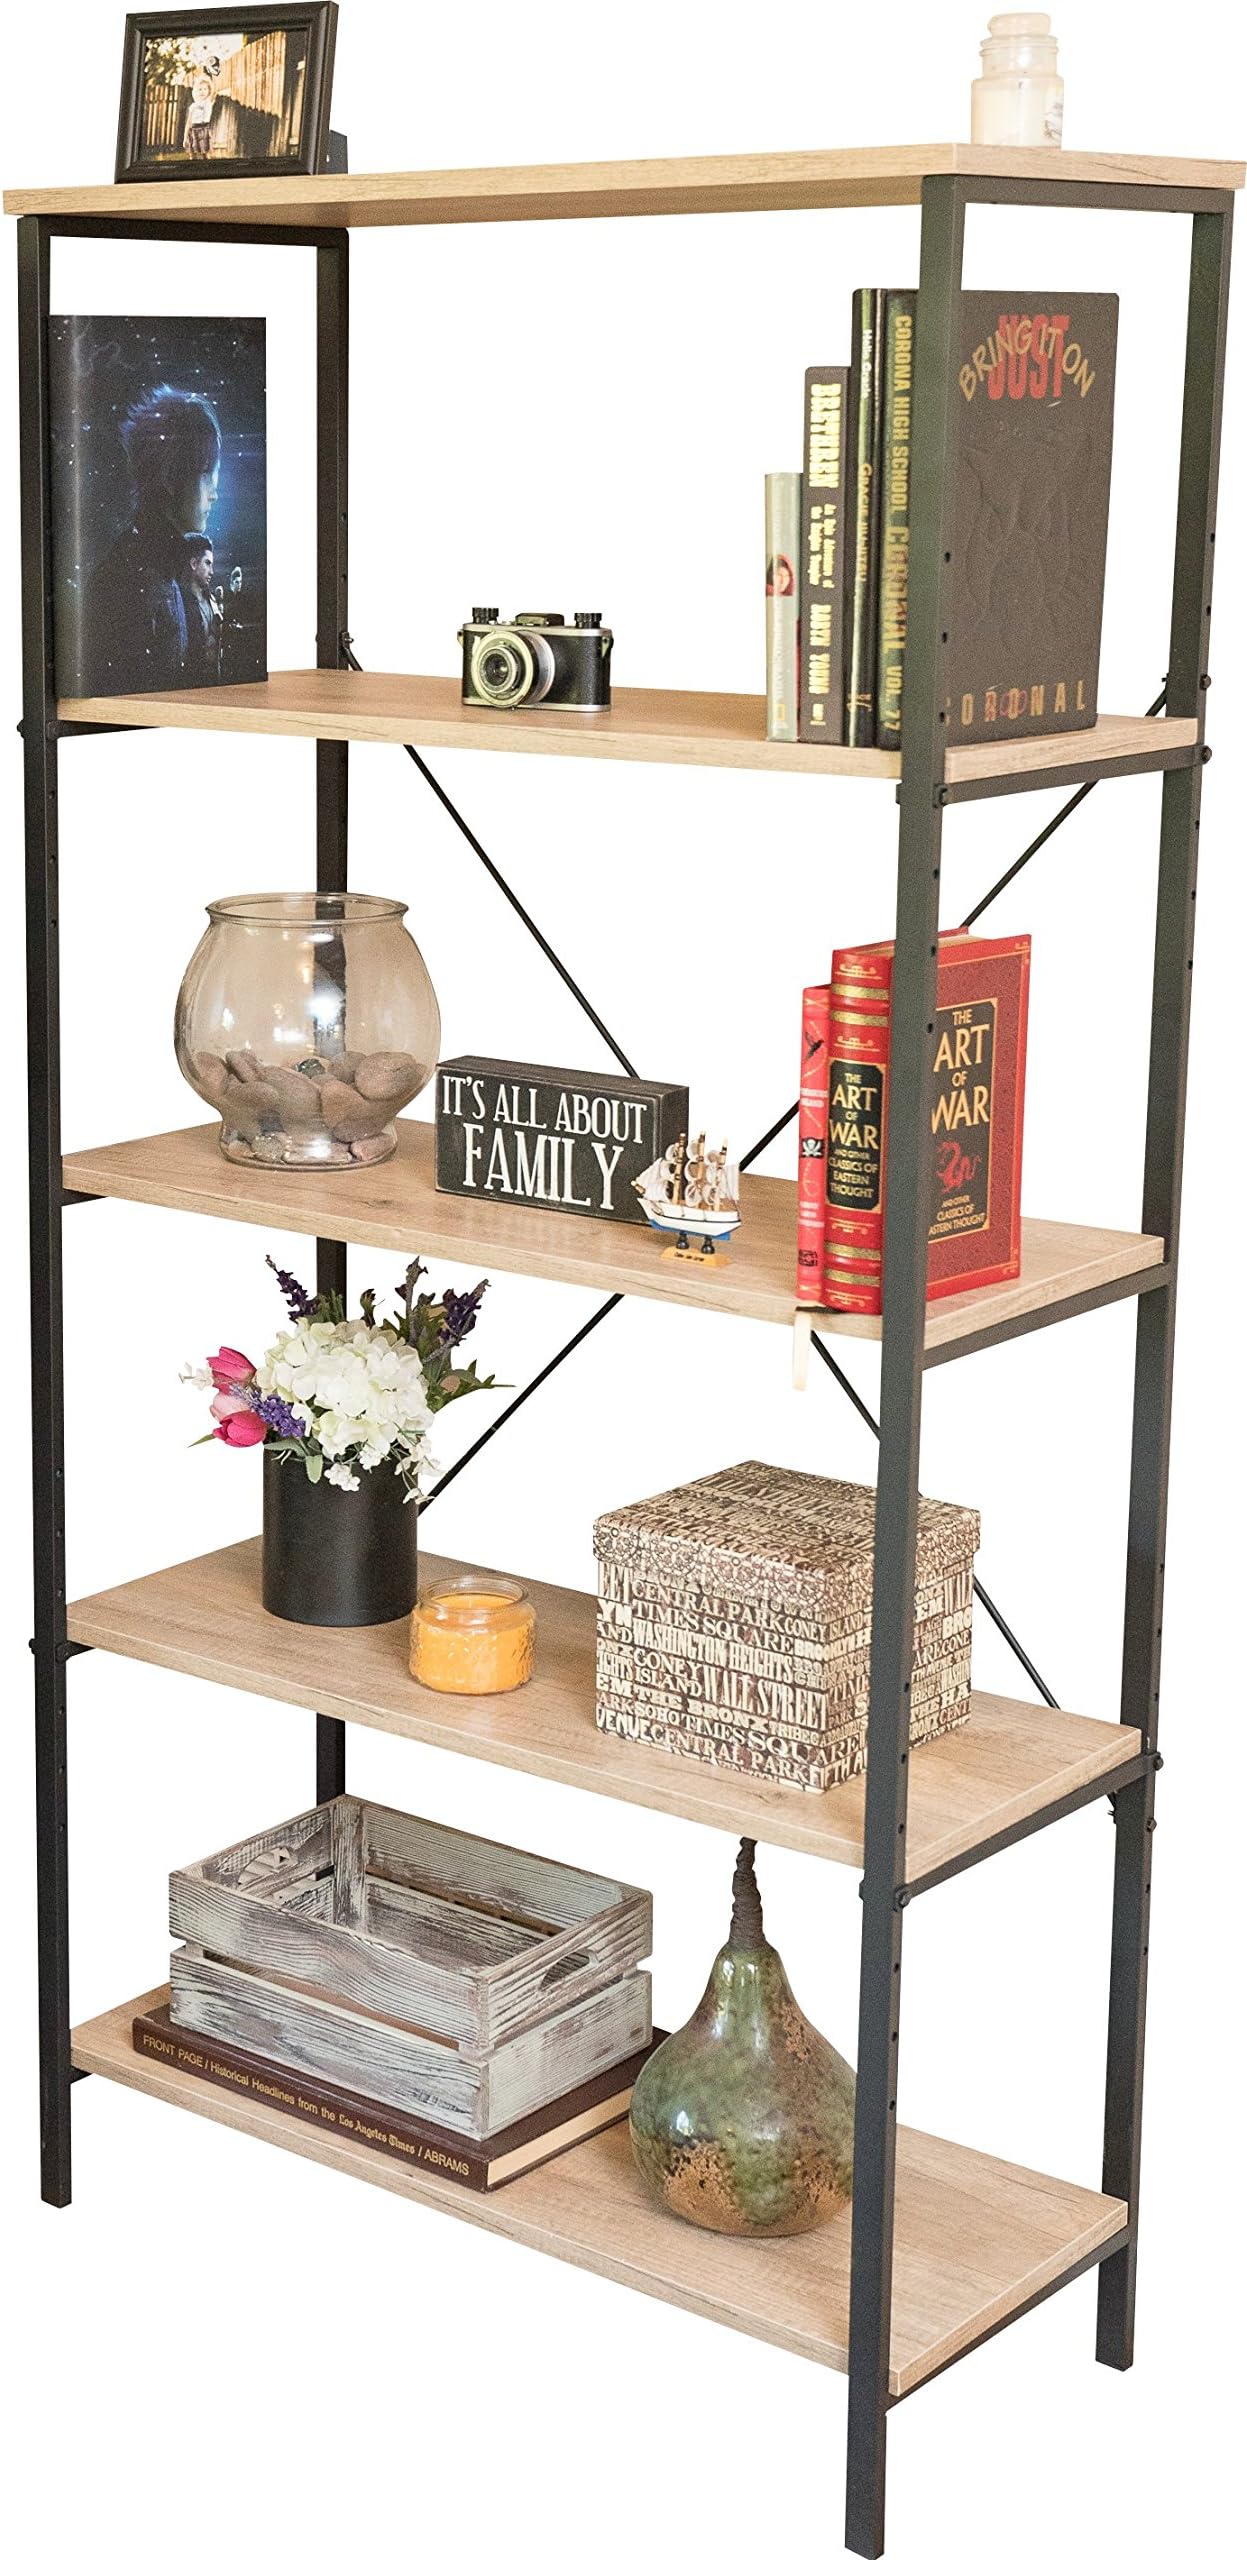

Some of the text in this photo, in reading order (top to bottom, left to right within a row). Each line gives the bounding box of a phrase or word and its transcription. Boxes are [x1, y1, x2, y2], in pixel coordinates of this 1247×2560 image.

[959, 319, 1096, 401] BRING IT ON
[988, 314, 1072, 400] JUST
[809, 383, 842, 489] BRETHREN
[890, 315, 912, 513] CORONA HIGH SCHOOL
[881, 525, 909, 655] CORONAL
[809, 603, 832, 647] ROBYN
[808, 653, 831, 694] YOUNG
[883, 709, 900, 731] 77
[945, 679, 1086, 727] ORONAL
[952, 1008, 973, 1026] THE
[933, 1024, 990, 1073] ART
[832, 1084, 877, 1111] ART
[844, 1073, 862, 1084] THE
[952, 1070, 968, 1087] OF
[442, 1074, 647, 1144] IT'S ALL ABOUT
[845, 1111, 858, 1121] OF
[931, 1085, 991, 1134] WAR
[829, 1119, 879, 1149] WAR
[462, 1122, 624, 1211] FAMILY
[829, 1157, 878, 1173] CLASSICS OF
[833, 1171, 869, 1185] EASTERN
[830, 1182, 874, 1198] THOUGHT
[937, 1204, 975, 1222] CLASSICS OF
[928, 1212, 986, 1236] ASTERN THOUGHT
[632, 1577, 724, 1619] CENTRAL
[727, 1599, 785, 1634] PARK
[784, 1614, 826, 1644] CONEY
[632, 1597, 699, 1633] TIMES
[702, 1613, 793, 1657] SQUARE
[632, 1615, 726, 1668] WASHINGTON
[728, 1640, 793, 1685] HEIGHTS
[633, 1645, 702, 1682] CONEY
[702, 1662, 753, 1714] WALL
[758, 1679, 829, 1731] STREET
[635, 1665, 702, 1699] ISLAND
[633, 1683, 682, 1711] THE
[686, 1697, 768, 1734] BRONX
[768, 1719, 828, 1748] TRIBECA
[634, 1699, 680, 1727] SOHO
[679, 1710, 746, 1747] TIMES
[748, 1731, 860, 1767] SQUARE
[650, 1721, 743, 1766] CENTRAL
[750, 1749, 810, 1784] PARK
[143, 2034, 470, 2176] FRONT PAGE / Historical Headlines from the Los Angeles Times / ABRAMS
